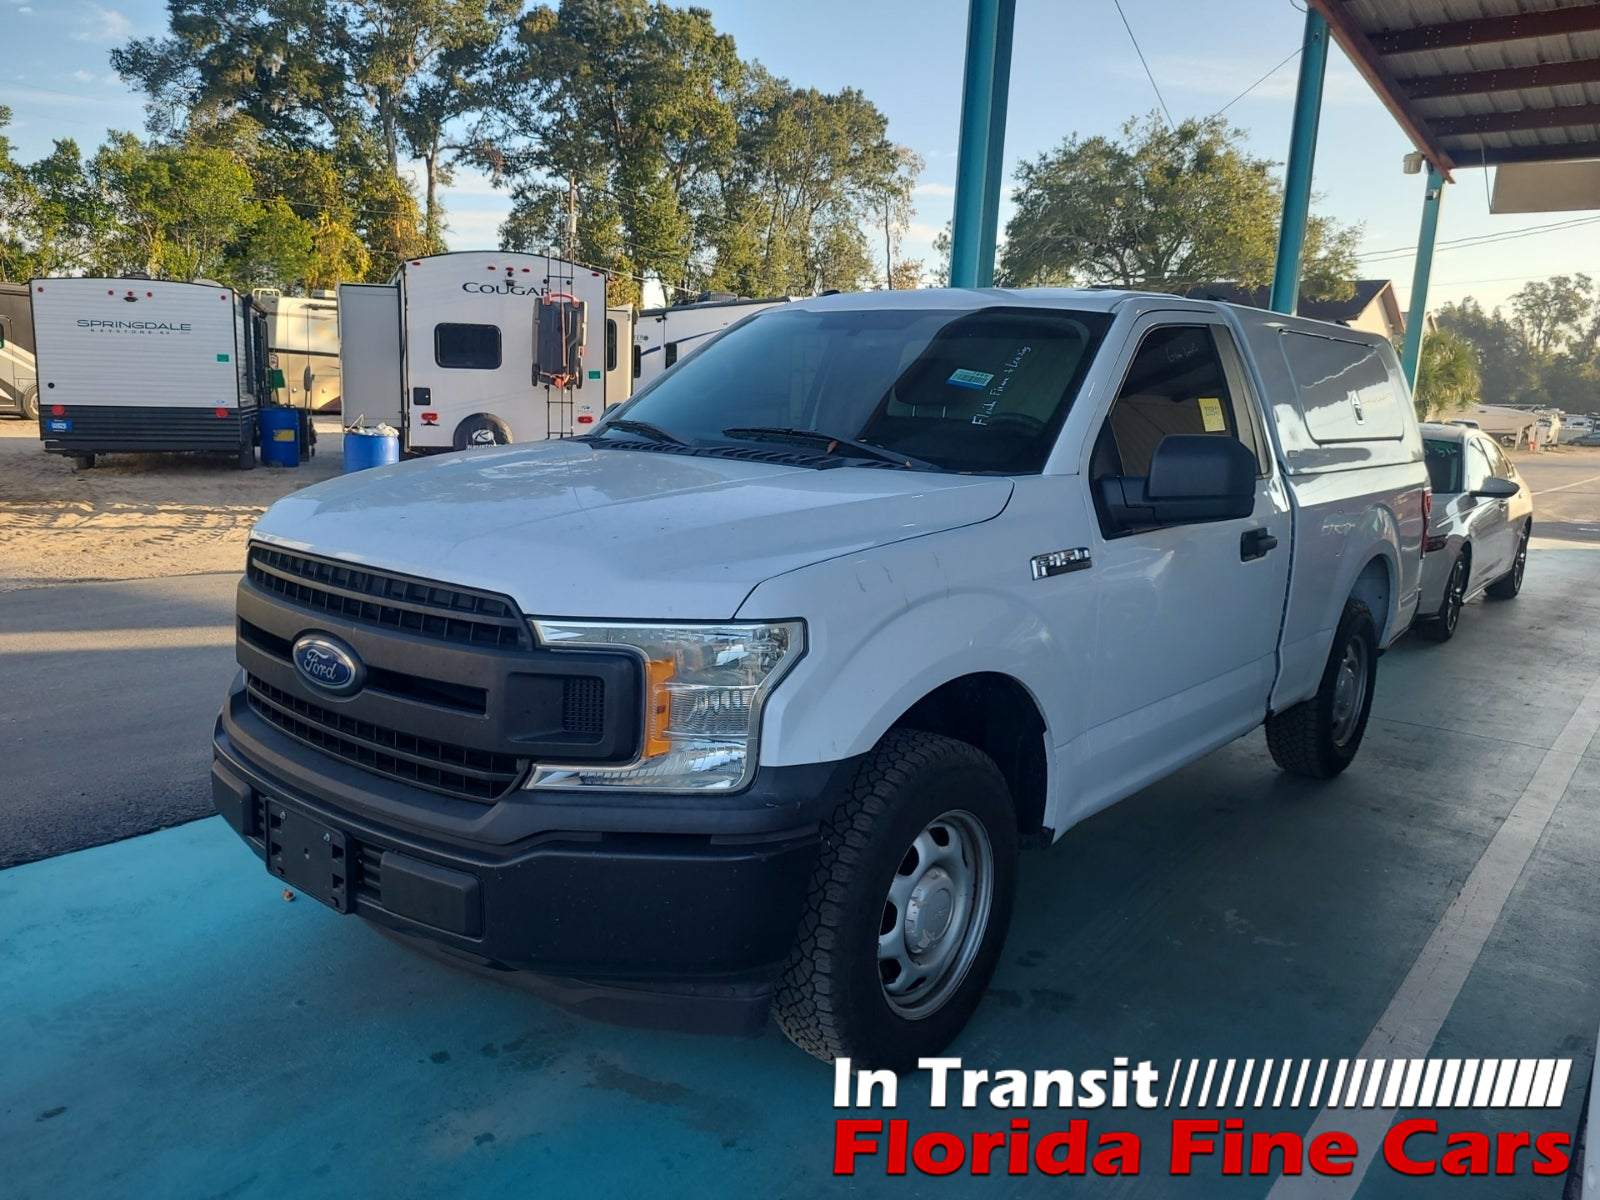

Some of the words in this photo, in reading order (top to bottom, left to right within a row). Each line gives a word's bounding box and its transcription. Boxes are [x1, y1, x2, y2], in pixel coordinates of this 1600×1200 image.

[462, 281, 551, 297] COUGAR
[77, 319, 192, 332] SPRINGDALE
[303, 648, 338, 680] Ford
